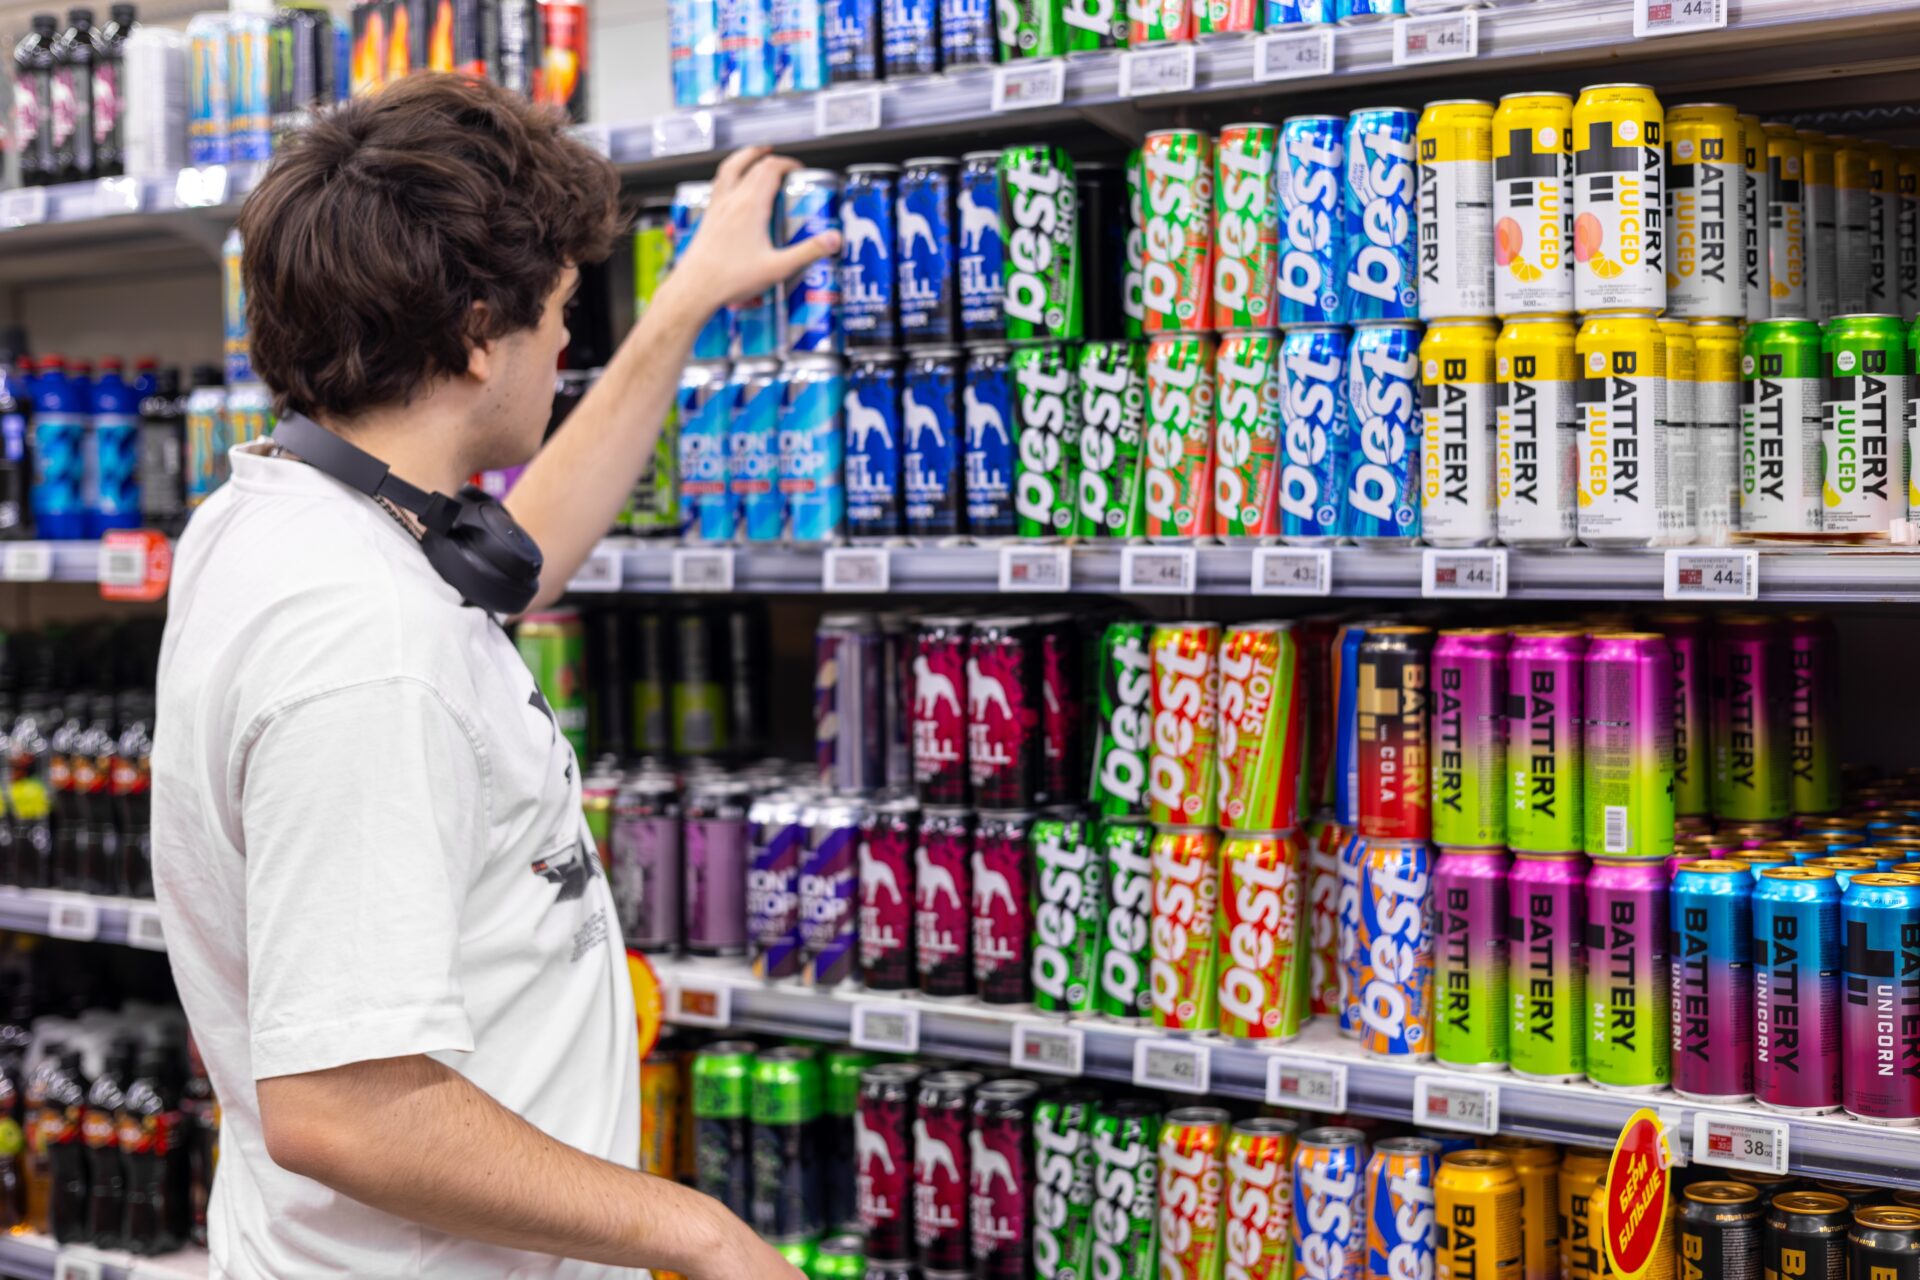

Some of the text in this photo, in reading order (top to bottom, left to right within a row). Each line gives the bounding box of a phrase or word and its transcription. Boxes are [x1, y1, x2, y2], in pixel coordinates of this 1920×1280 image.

[1438, 32, 1455, 46] 44
[1683, 1, 1702, 16] 44
[1003, 157, 1062, 325] best
[1143, 147, 1201, 316] best
[1213, 140, 1275, 312] best
[1276, 130, 1345, 307] best
[1347, 123, 1419, 304] best
[1421, 138, 1440, 285] BATTERY
[1539, 176, 1559, 270] JUICED
[1618, 176, 1640, 266] JUICED
[1643, 121, 1663, 274] BATTERY
[1675, 192, 1696, 278] JUICED
[1700, 138, 1725, 285] BATTERY
[1785, 206, 1801, 288] JUICED
[1900, 174, 1918, 301] BATTERY
[1016, 354, 1069, 524] best
[1080, 350, 1129, 524] best
[1118, 369, 1145, 445] SHOT
[1146, 352, 1200, 523] best
[1216, 354, 1269, 522] best
[1279, 347, 1341, 521] best
[1348, 345, 1419, 521] best
[1444, 359, 1468, 505] BATTERY
[1514, 355, 1538, 505] BATTERY
[1590, 405, 1608, 498] JUICED
[1613, 350, 1639, 504] BATTERY
[1743, 408, 1756, 495] JUICED
[1760, 354, 1784, 503] BATTERY
[1837, 405, 1856, 494] JUICED
[1862, 350, 1888, 502] BATTERY
[1466, 569, 1485, 582] 44
[1713, 570, 1734, 584] 44
[1100, 636, 1150, 802] best
[1151, 640, 1208, 810] best
[1241, 658, 1274, 735] SHOT
[1402, 664, 1427, 808] BATTERY
[1442, 667, 1462, 814] BATTERY
[1531, 670, 1556, 820] BATTERY
[1731, 654, 1755, 790] BATTERY
[1792, 650, 1814, 783] BATTERY
[1380, 745, 1396, 803] COLA
[1514, 771, 1526, 810] MIX
[1031, 837, 1087, 998] best
[1102, 839, 1153, 1005] best
[1151, 847, 1202, 1014] best
[1218, 853, 1288, 1025] best
[1361, 860, 1428, 1040] best
[1447, 888, 1470, 1034] BATTERY
[1530, 894, 1554, 1043] BATTERY
[1611, 901, 1636, 1053] BATTERY
[1685, 908, 1709, 1062] BATTERY
[1515, 993, 1525, 1032] MIX
[1594, 1003, 1605, 1042] MIX
[1671, 963, 1682, 1052] UNICORN
[1757, 972, 1768, 1063] UNICORN
[1772, 915, 1799, 1074] BATTERY
[1876, 985, 1895, 1076] UNICORN
[1458, 1101, 1477, 1116] 37
[1744, 1139, 1764, 1156] 38
[1195, 1153, 1224, 1230] SHOT
[1302, 1161, 1358, 1280] est
[1387, 1176, 1438, 1280] est
[1453, 1204, 1476, 1280] BATT
[1618, 1166, 1662, 1254] БІЛЬШЕ
[1619, 1153, 1648, 1214] БЕРИ
